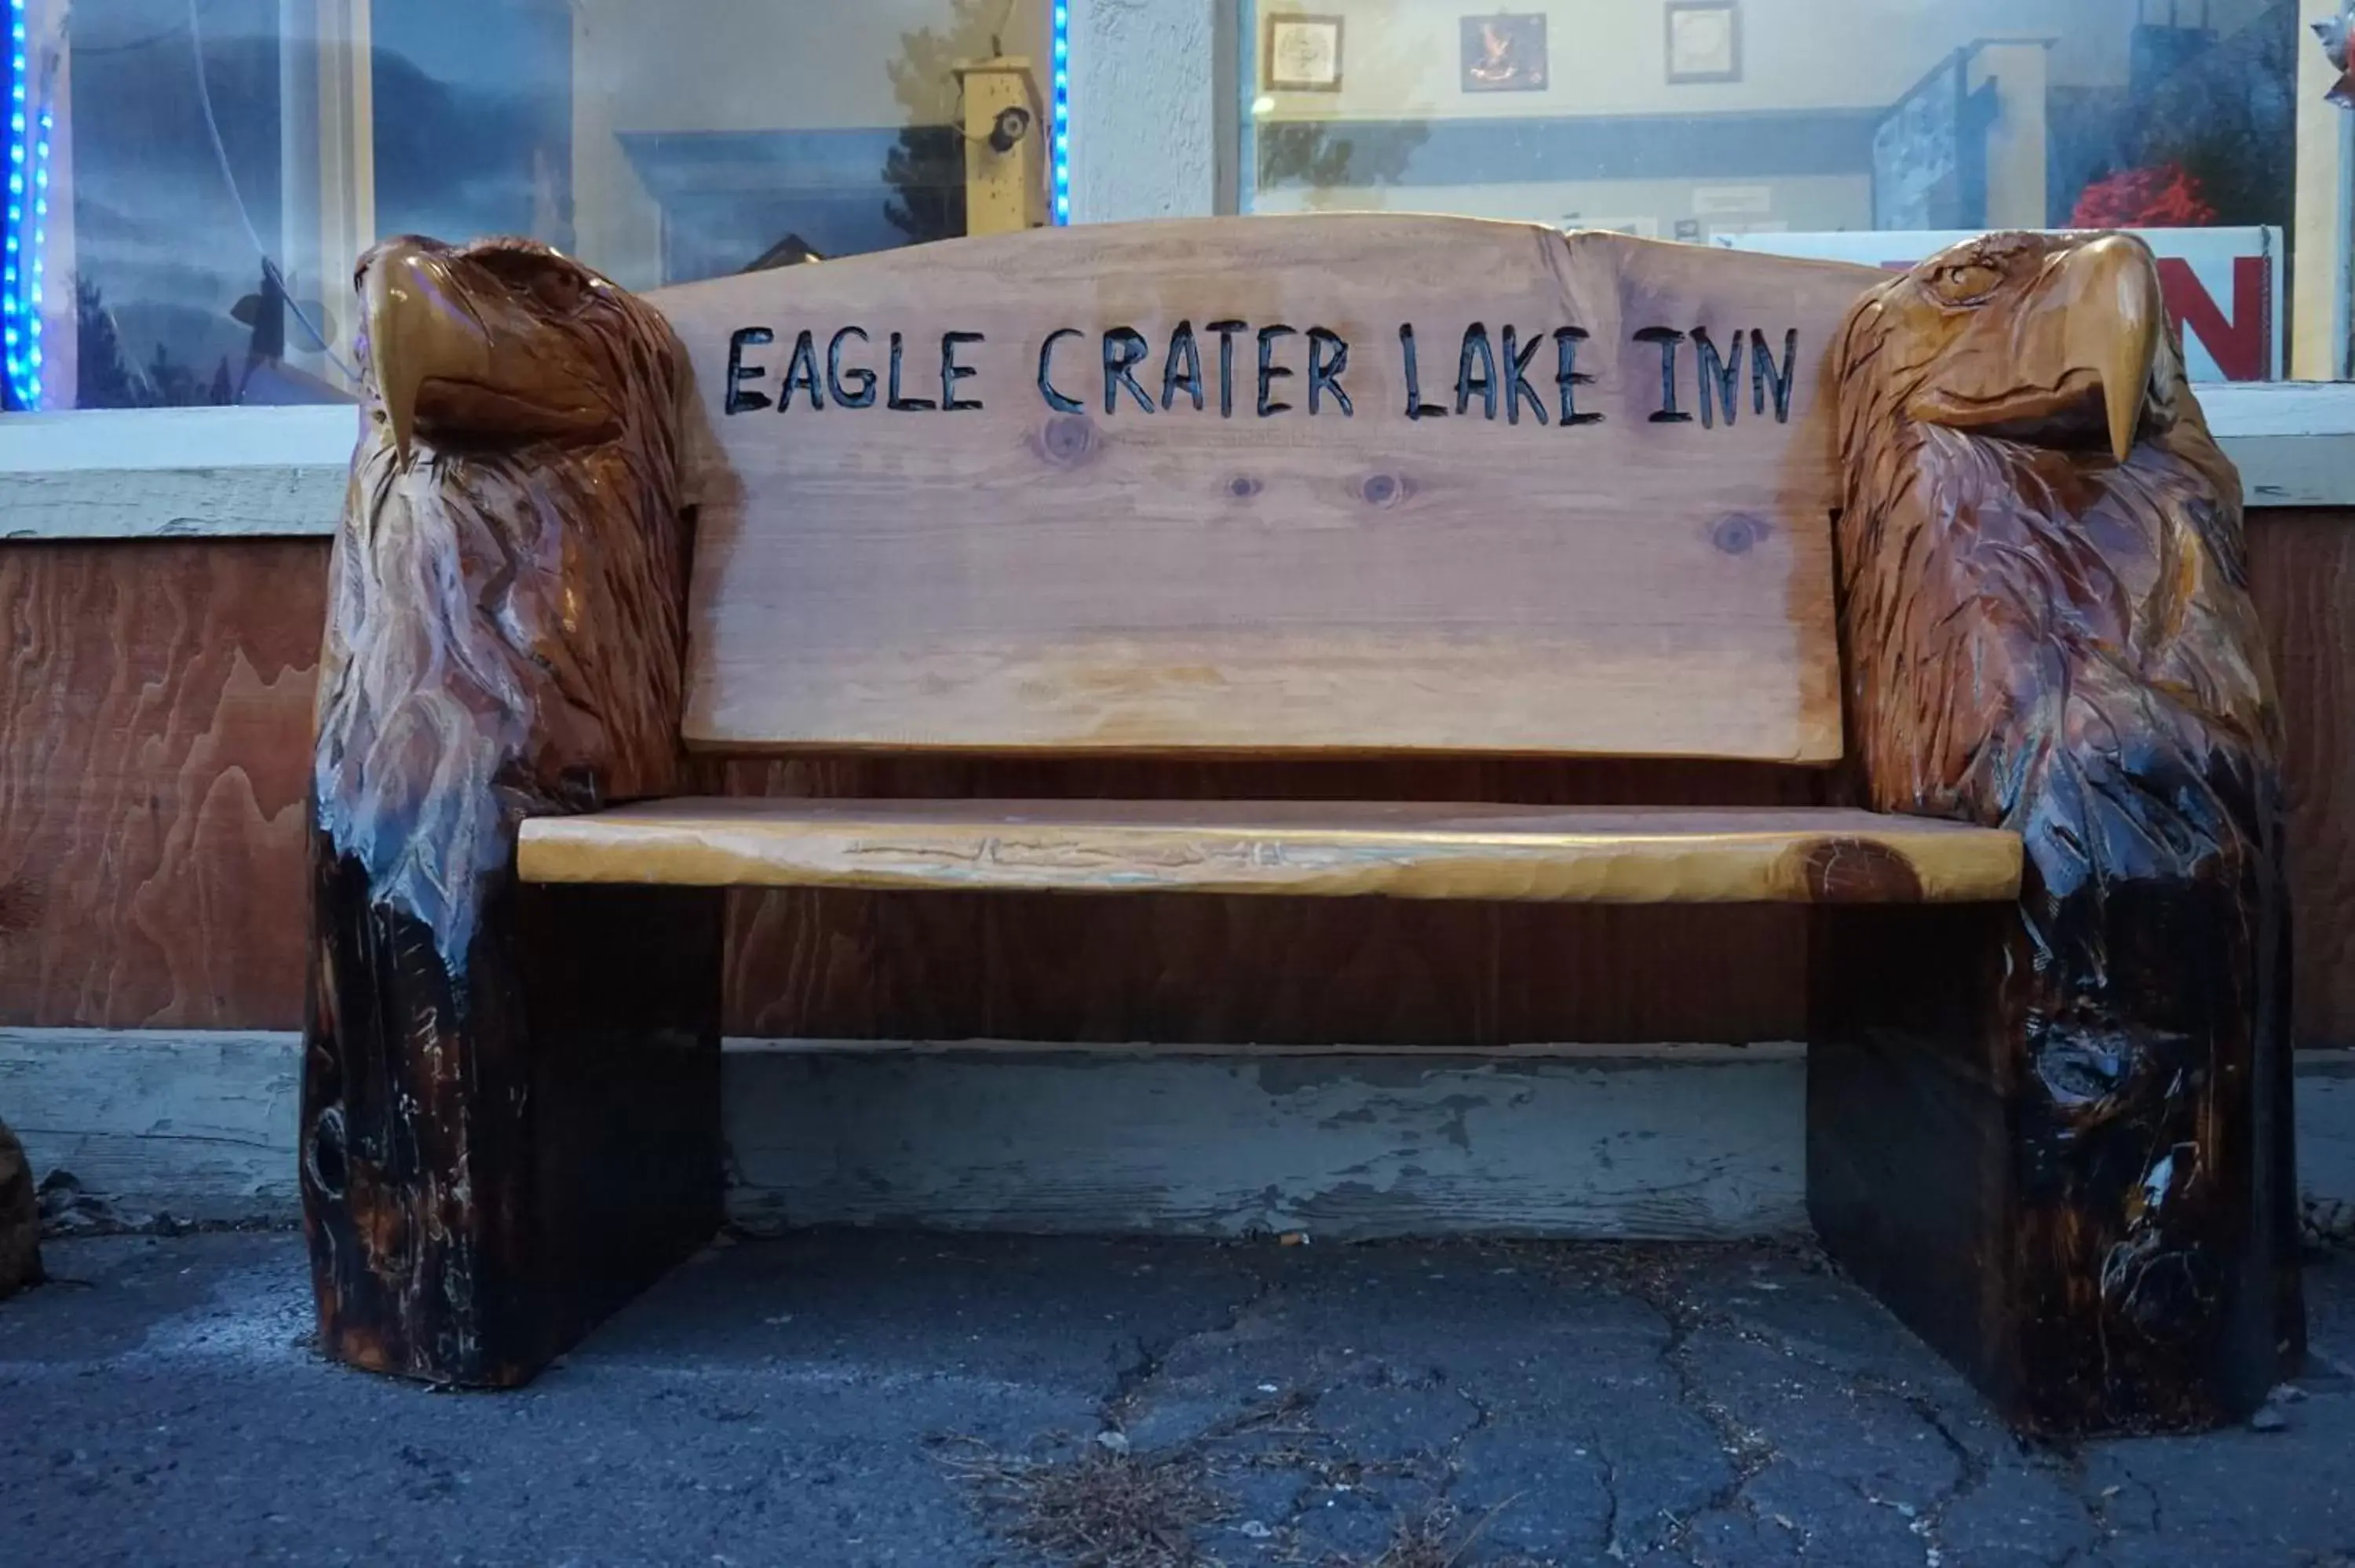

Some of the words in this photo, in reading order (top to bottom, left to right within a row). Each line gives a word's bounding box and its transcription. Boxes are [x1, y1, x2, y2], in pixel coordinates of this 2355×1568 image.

[725, 325, 985, 415] EAGLE
[1036, 319, 1354, 418] CRATER
[1398, 321, 1607, 426] LAKE
[1632, 325, 1798, 429] INN
